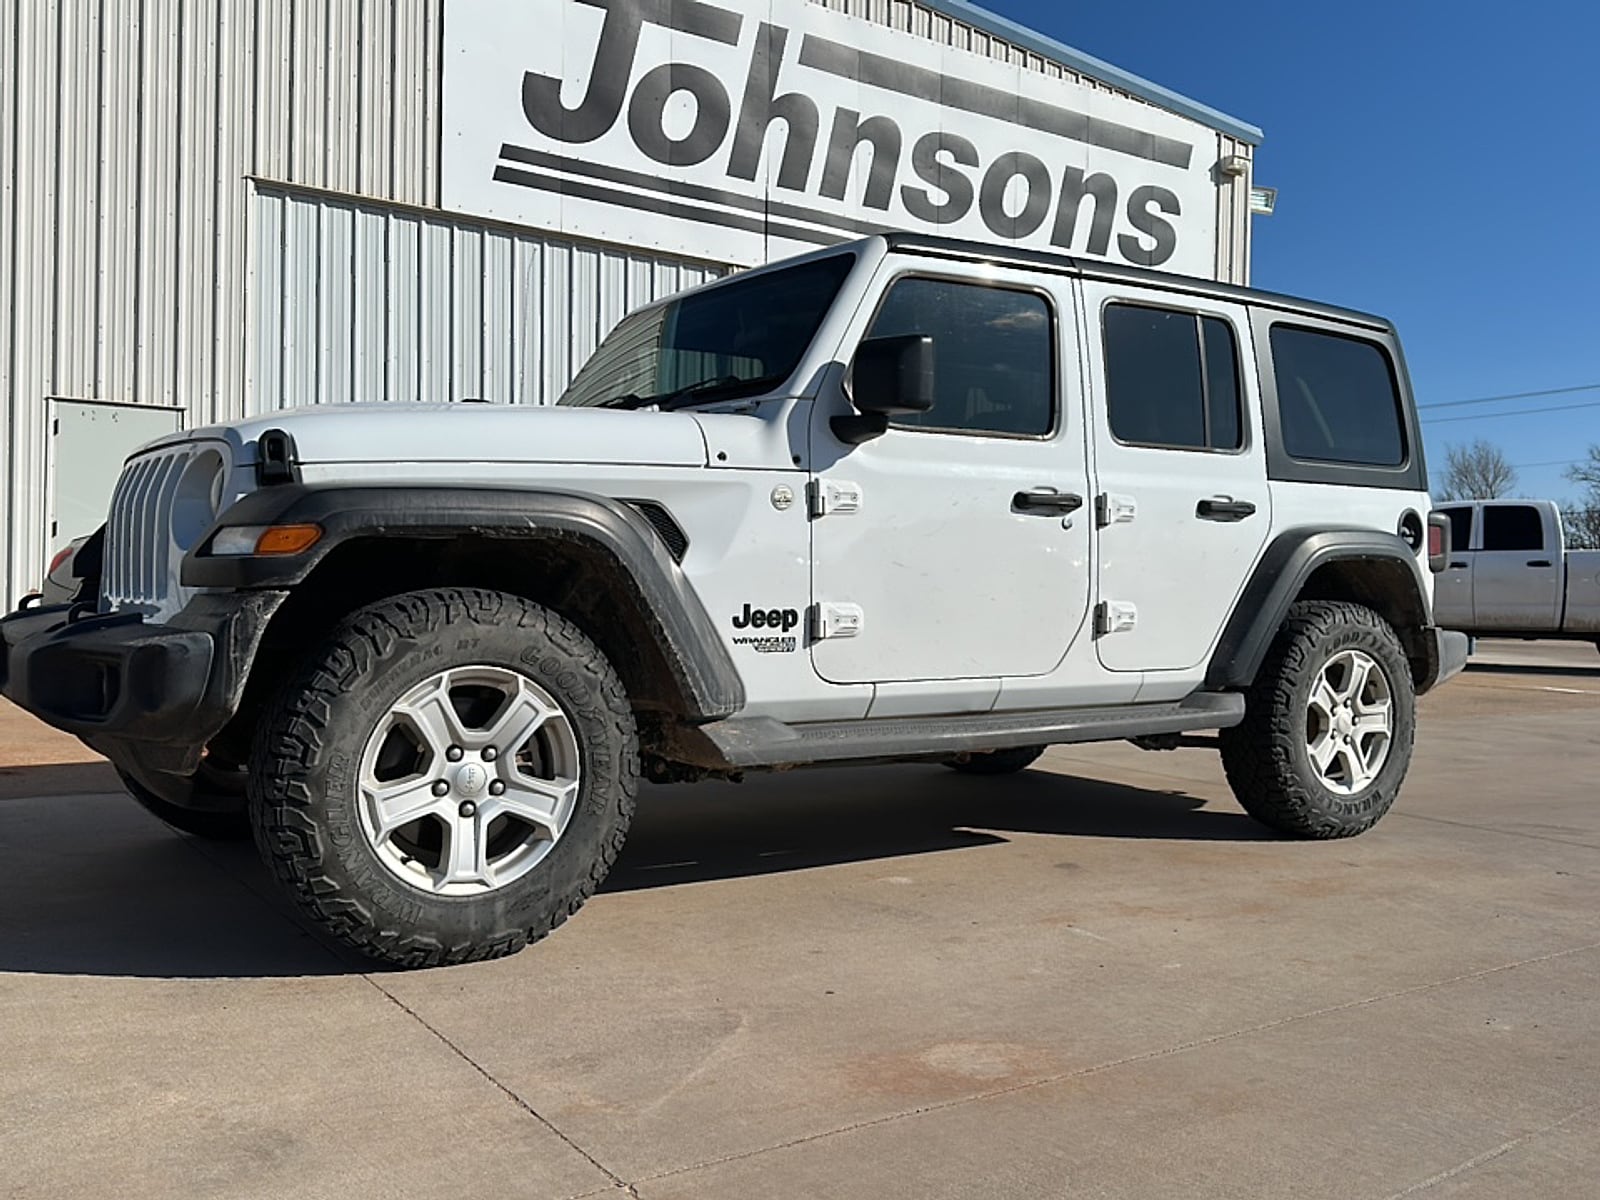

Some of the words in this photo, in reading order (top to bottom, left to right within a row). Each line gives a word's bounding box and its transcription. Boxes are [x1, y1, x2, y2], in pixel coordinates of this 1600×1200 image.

[522, 0, 1181, 266] Johnsons
[732, 603, 798, 632] Jeep
[520, 648, 612, 817] GOODYEAR
[325, 752, 423, 925] WRANGLER
